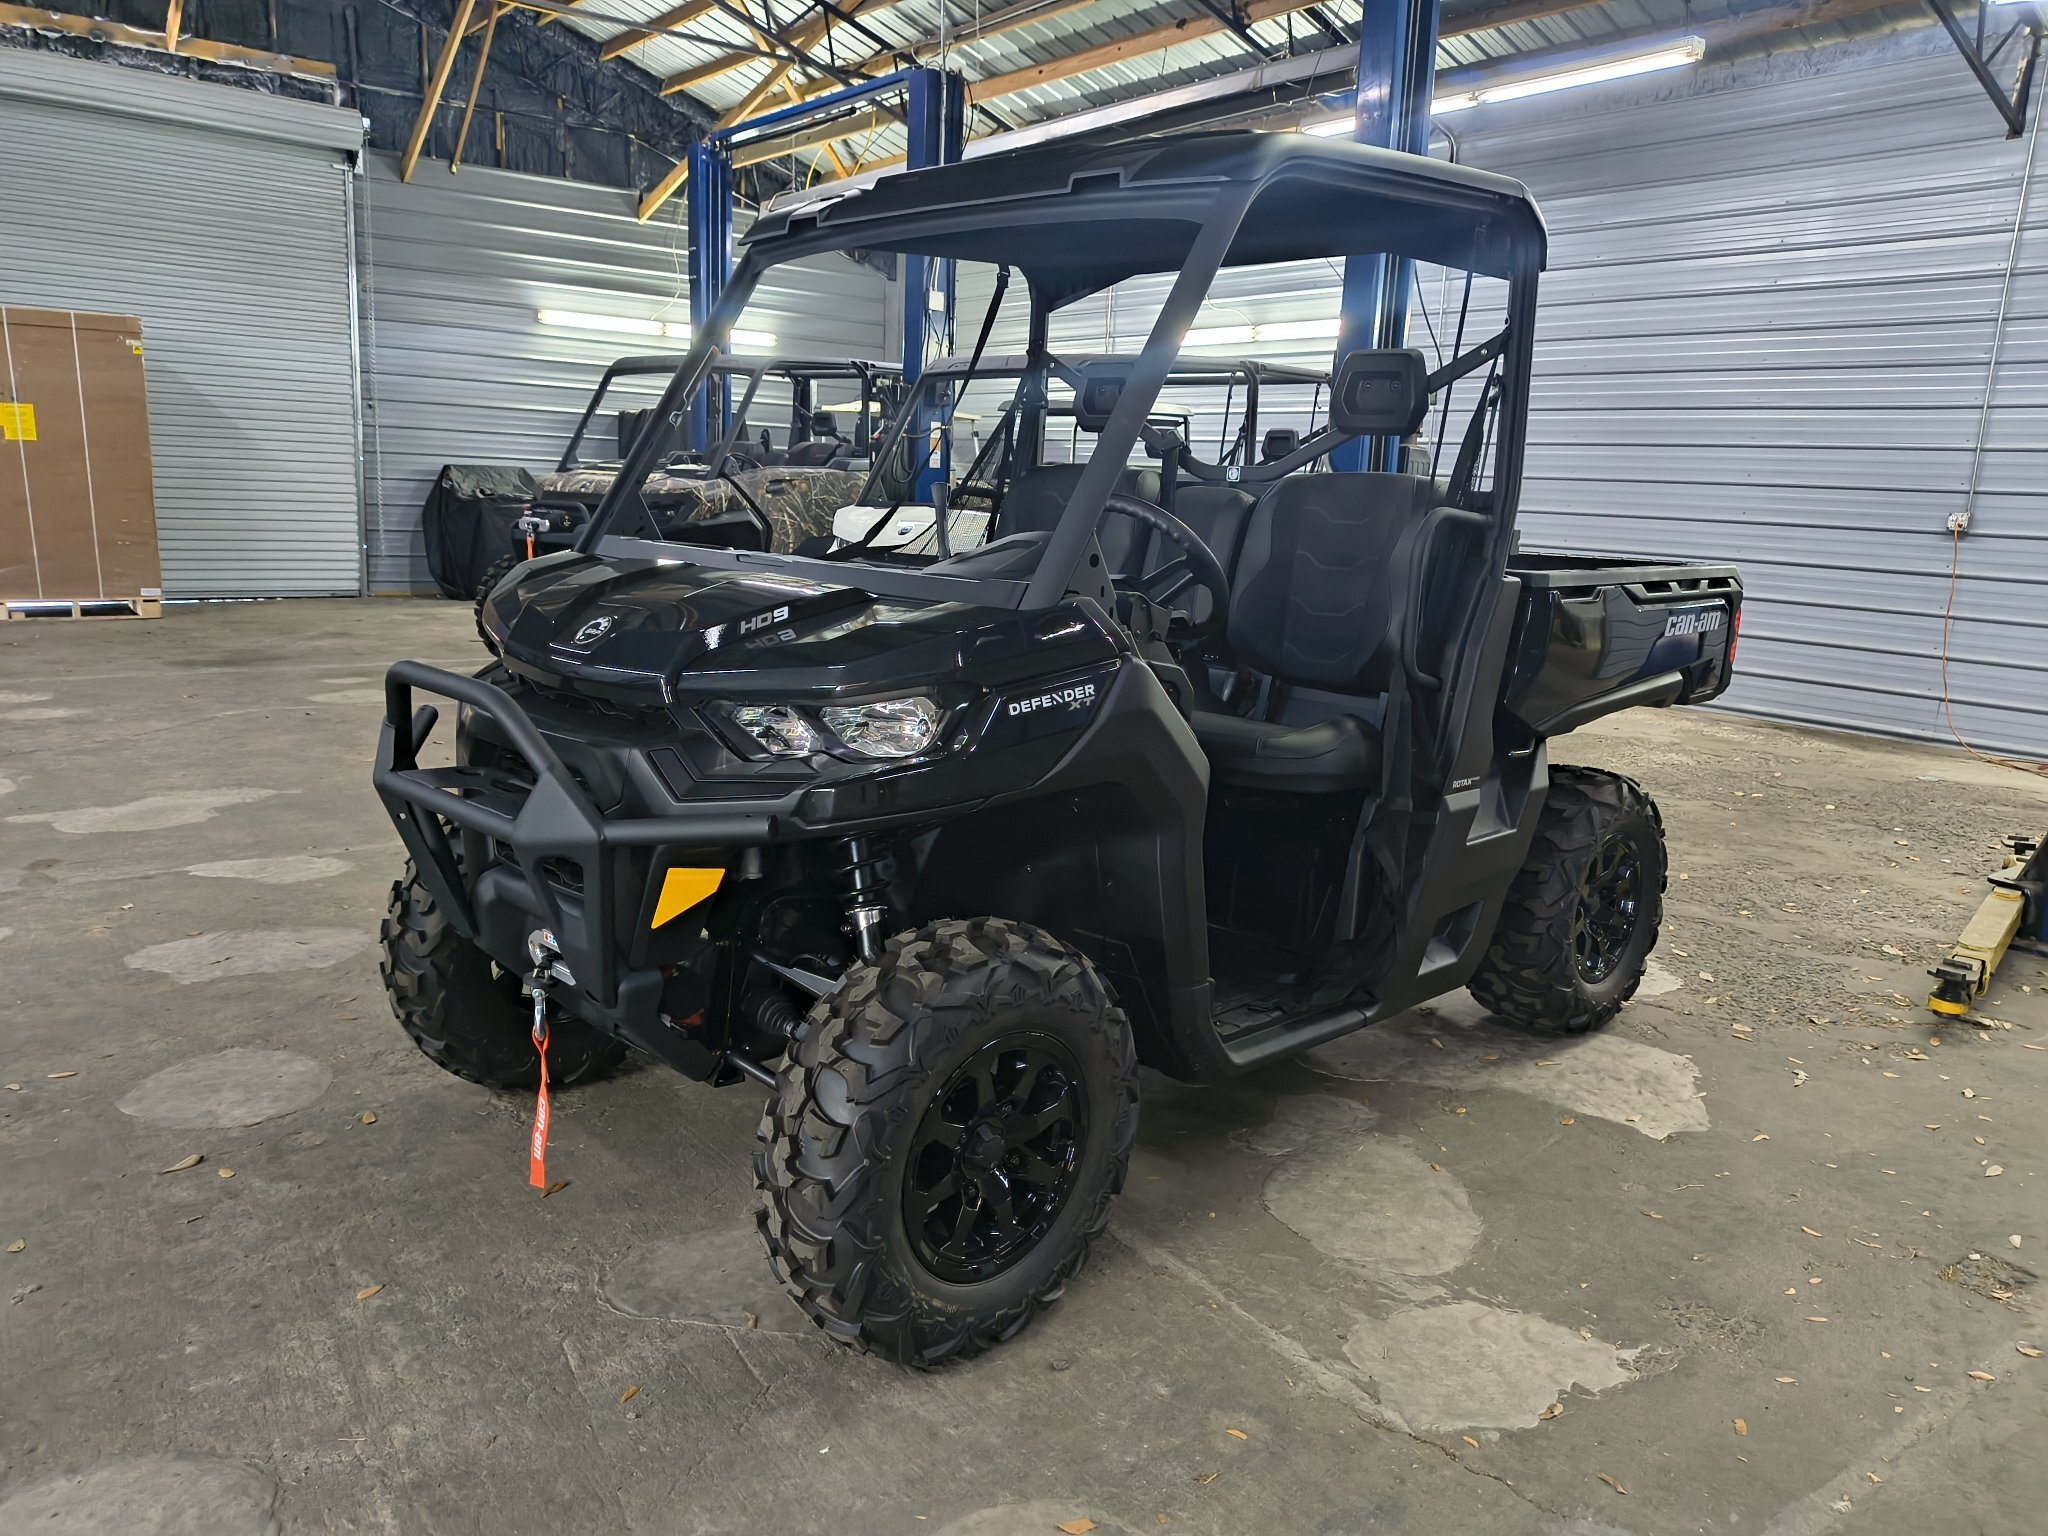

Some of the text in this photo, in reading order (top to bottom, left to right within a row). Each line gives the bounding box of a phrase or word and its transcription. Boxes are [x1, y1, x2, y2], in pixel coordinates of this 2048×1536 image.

[740, 606, 789, 635] HD9
[1008, 684, 1096, 716] DEFENDER
[1067, 696, 1096, 711] XT
[1452, 777, 1472, 789] ROTAX
